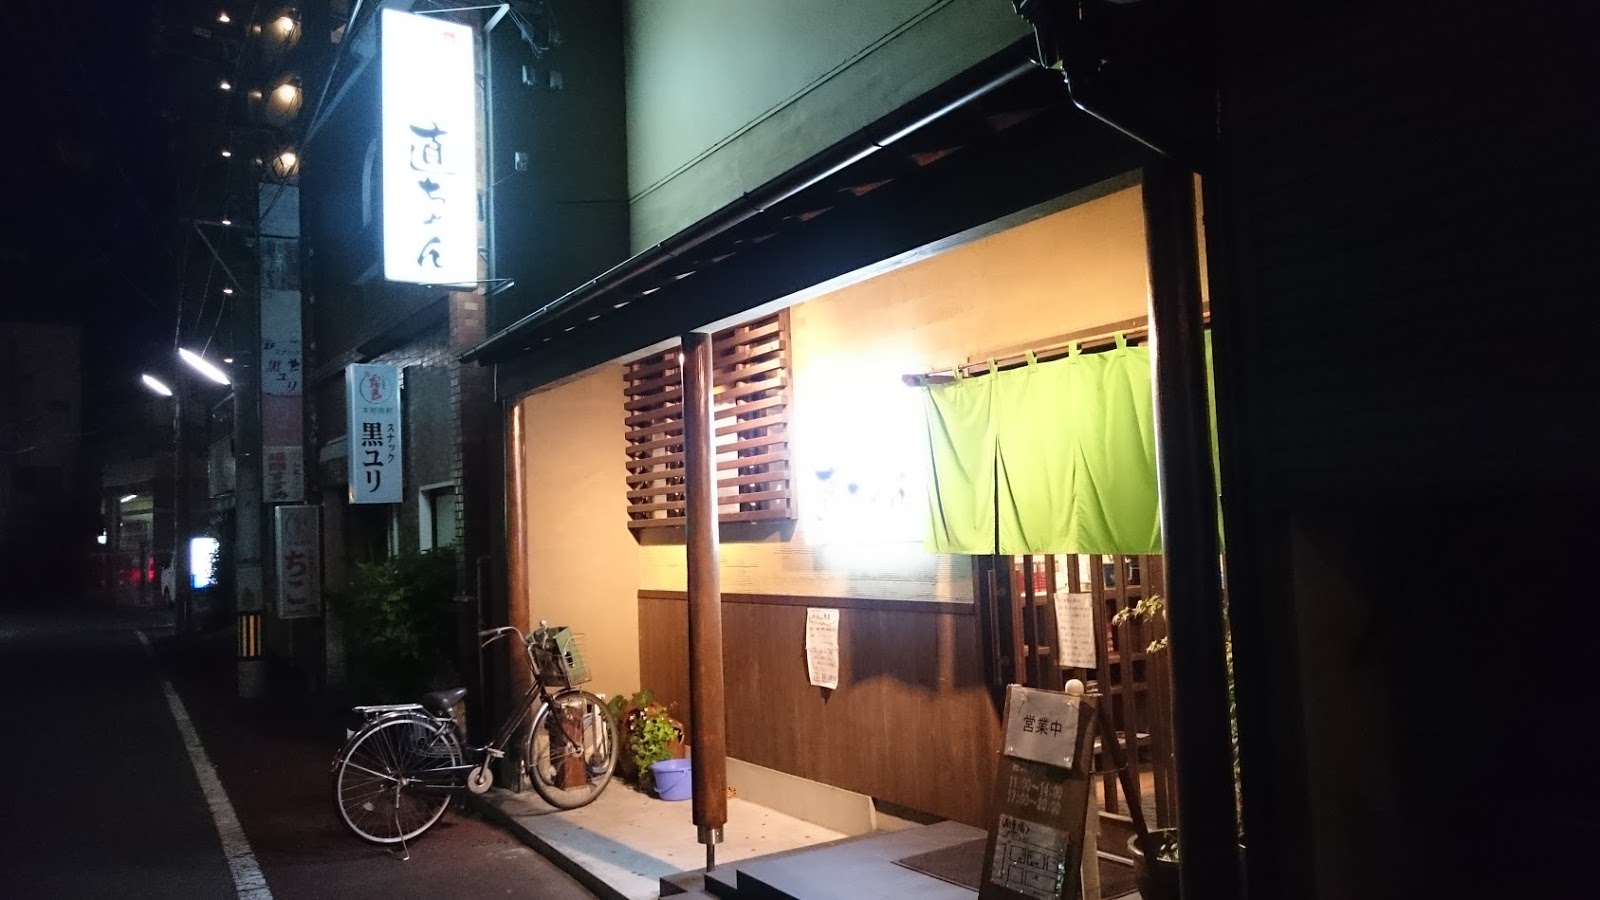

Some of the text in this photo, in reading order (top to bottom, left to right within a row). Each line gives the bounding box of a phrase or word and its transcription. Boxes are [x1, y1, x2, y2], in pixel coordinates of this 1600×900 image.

[265, 360, 297, 392] 黒ユリ
[362, 421, 384, 493] 黒ユリ
[387, 423, 396, 464] スナック
[1022, 715, 1063, 737] 営業中
